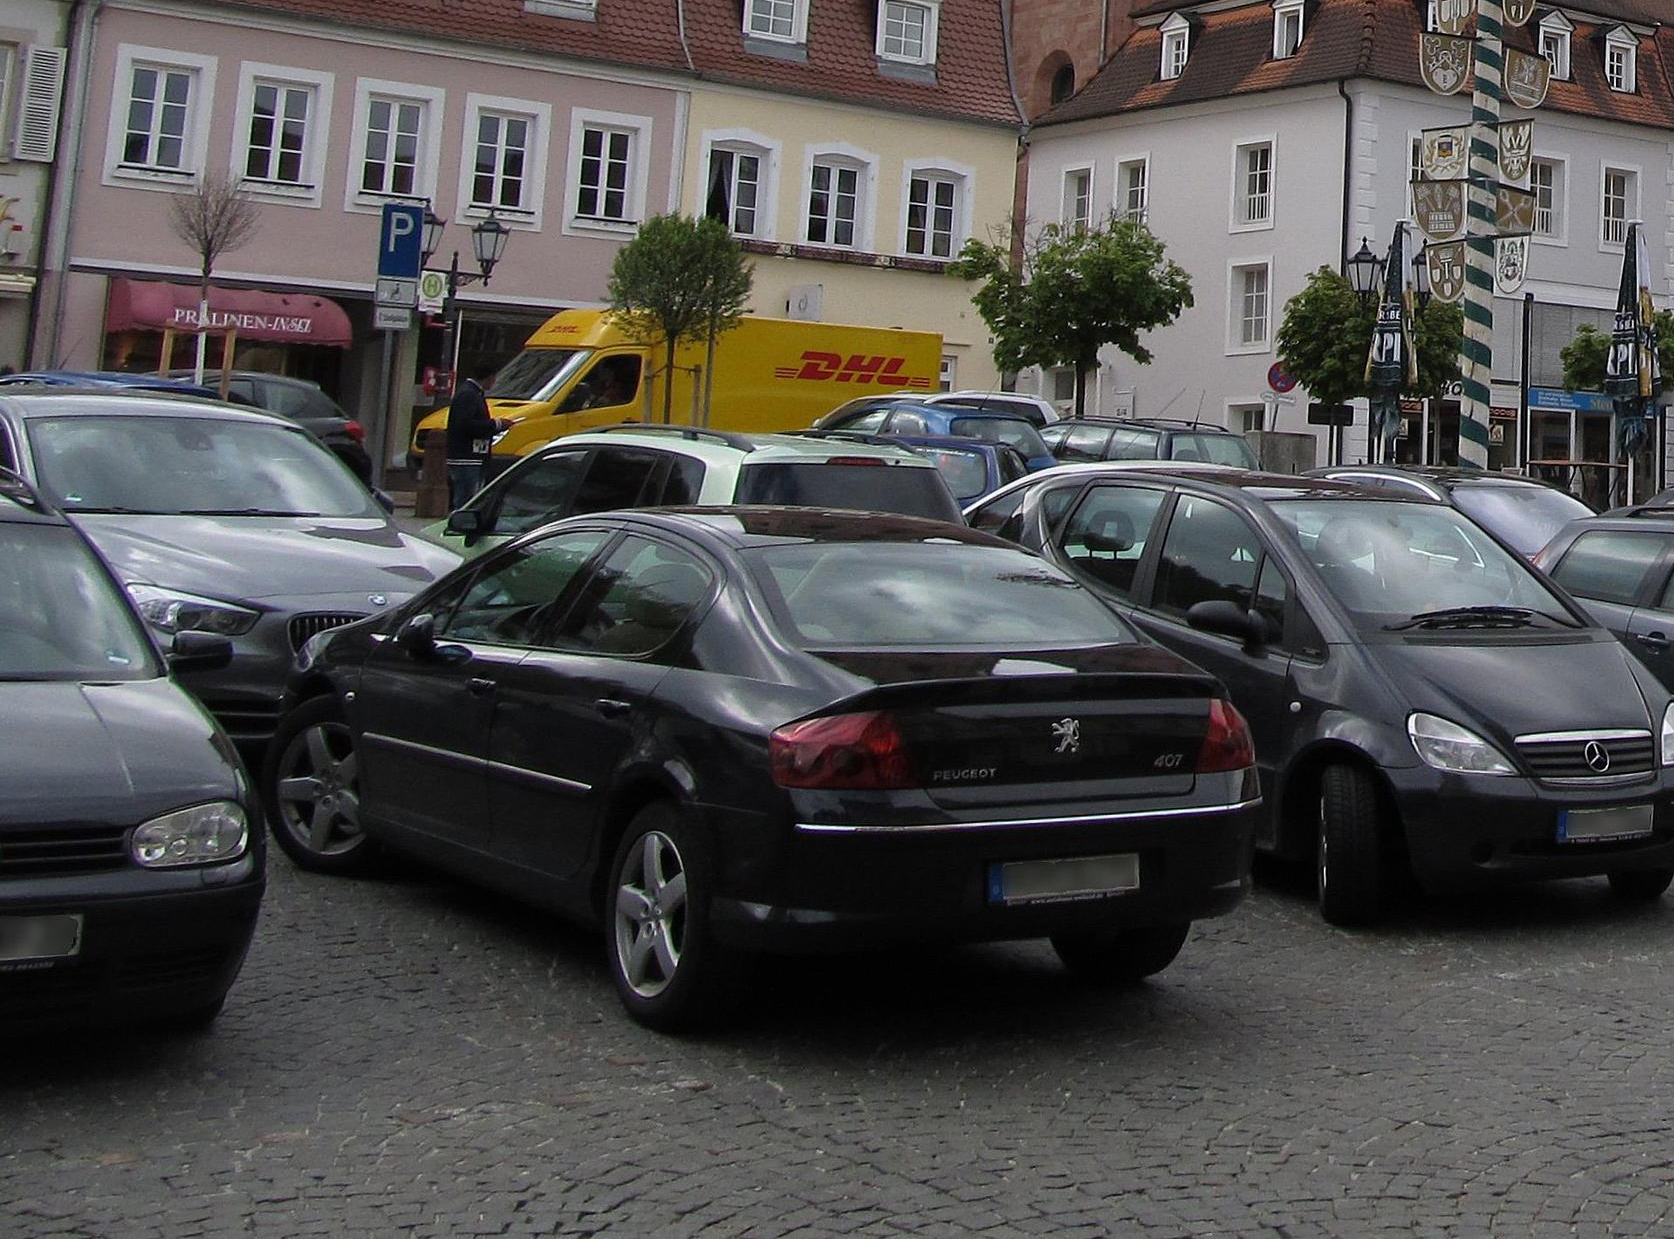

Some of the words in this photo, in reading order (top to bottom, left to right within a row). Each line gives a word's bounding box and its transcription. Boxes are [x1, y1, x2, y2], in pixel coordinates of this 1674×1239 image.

[388, 212, 415, 253] P
[796, 350, 910, 387] DHL
[1154, 753, 1184, 767] 407
[933, 767, 998, 782] PEUGEOT
